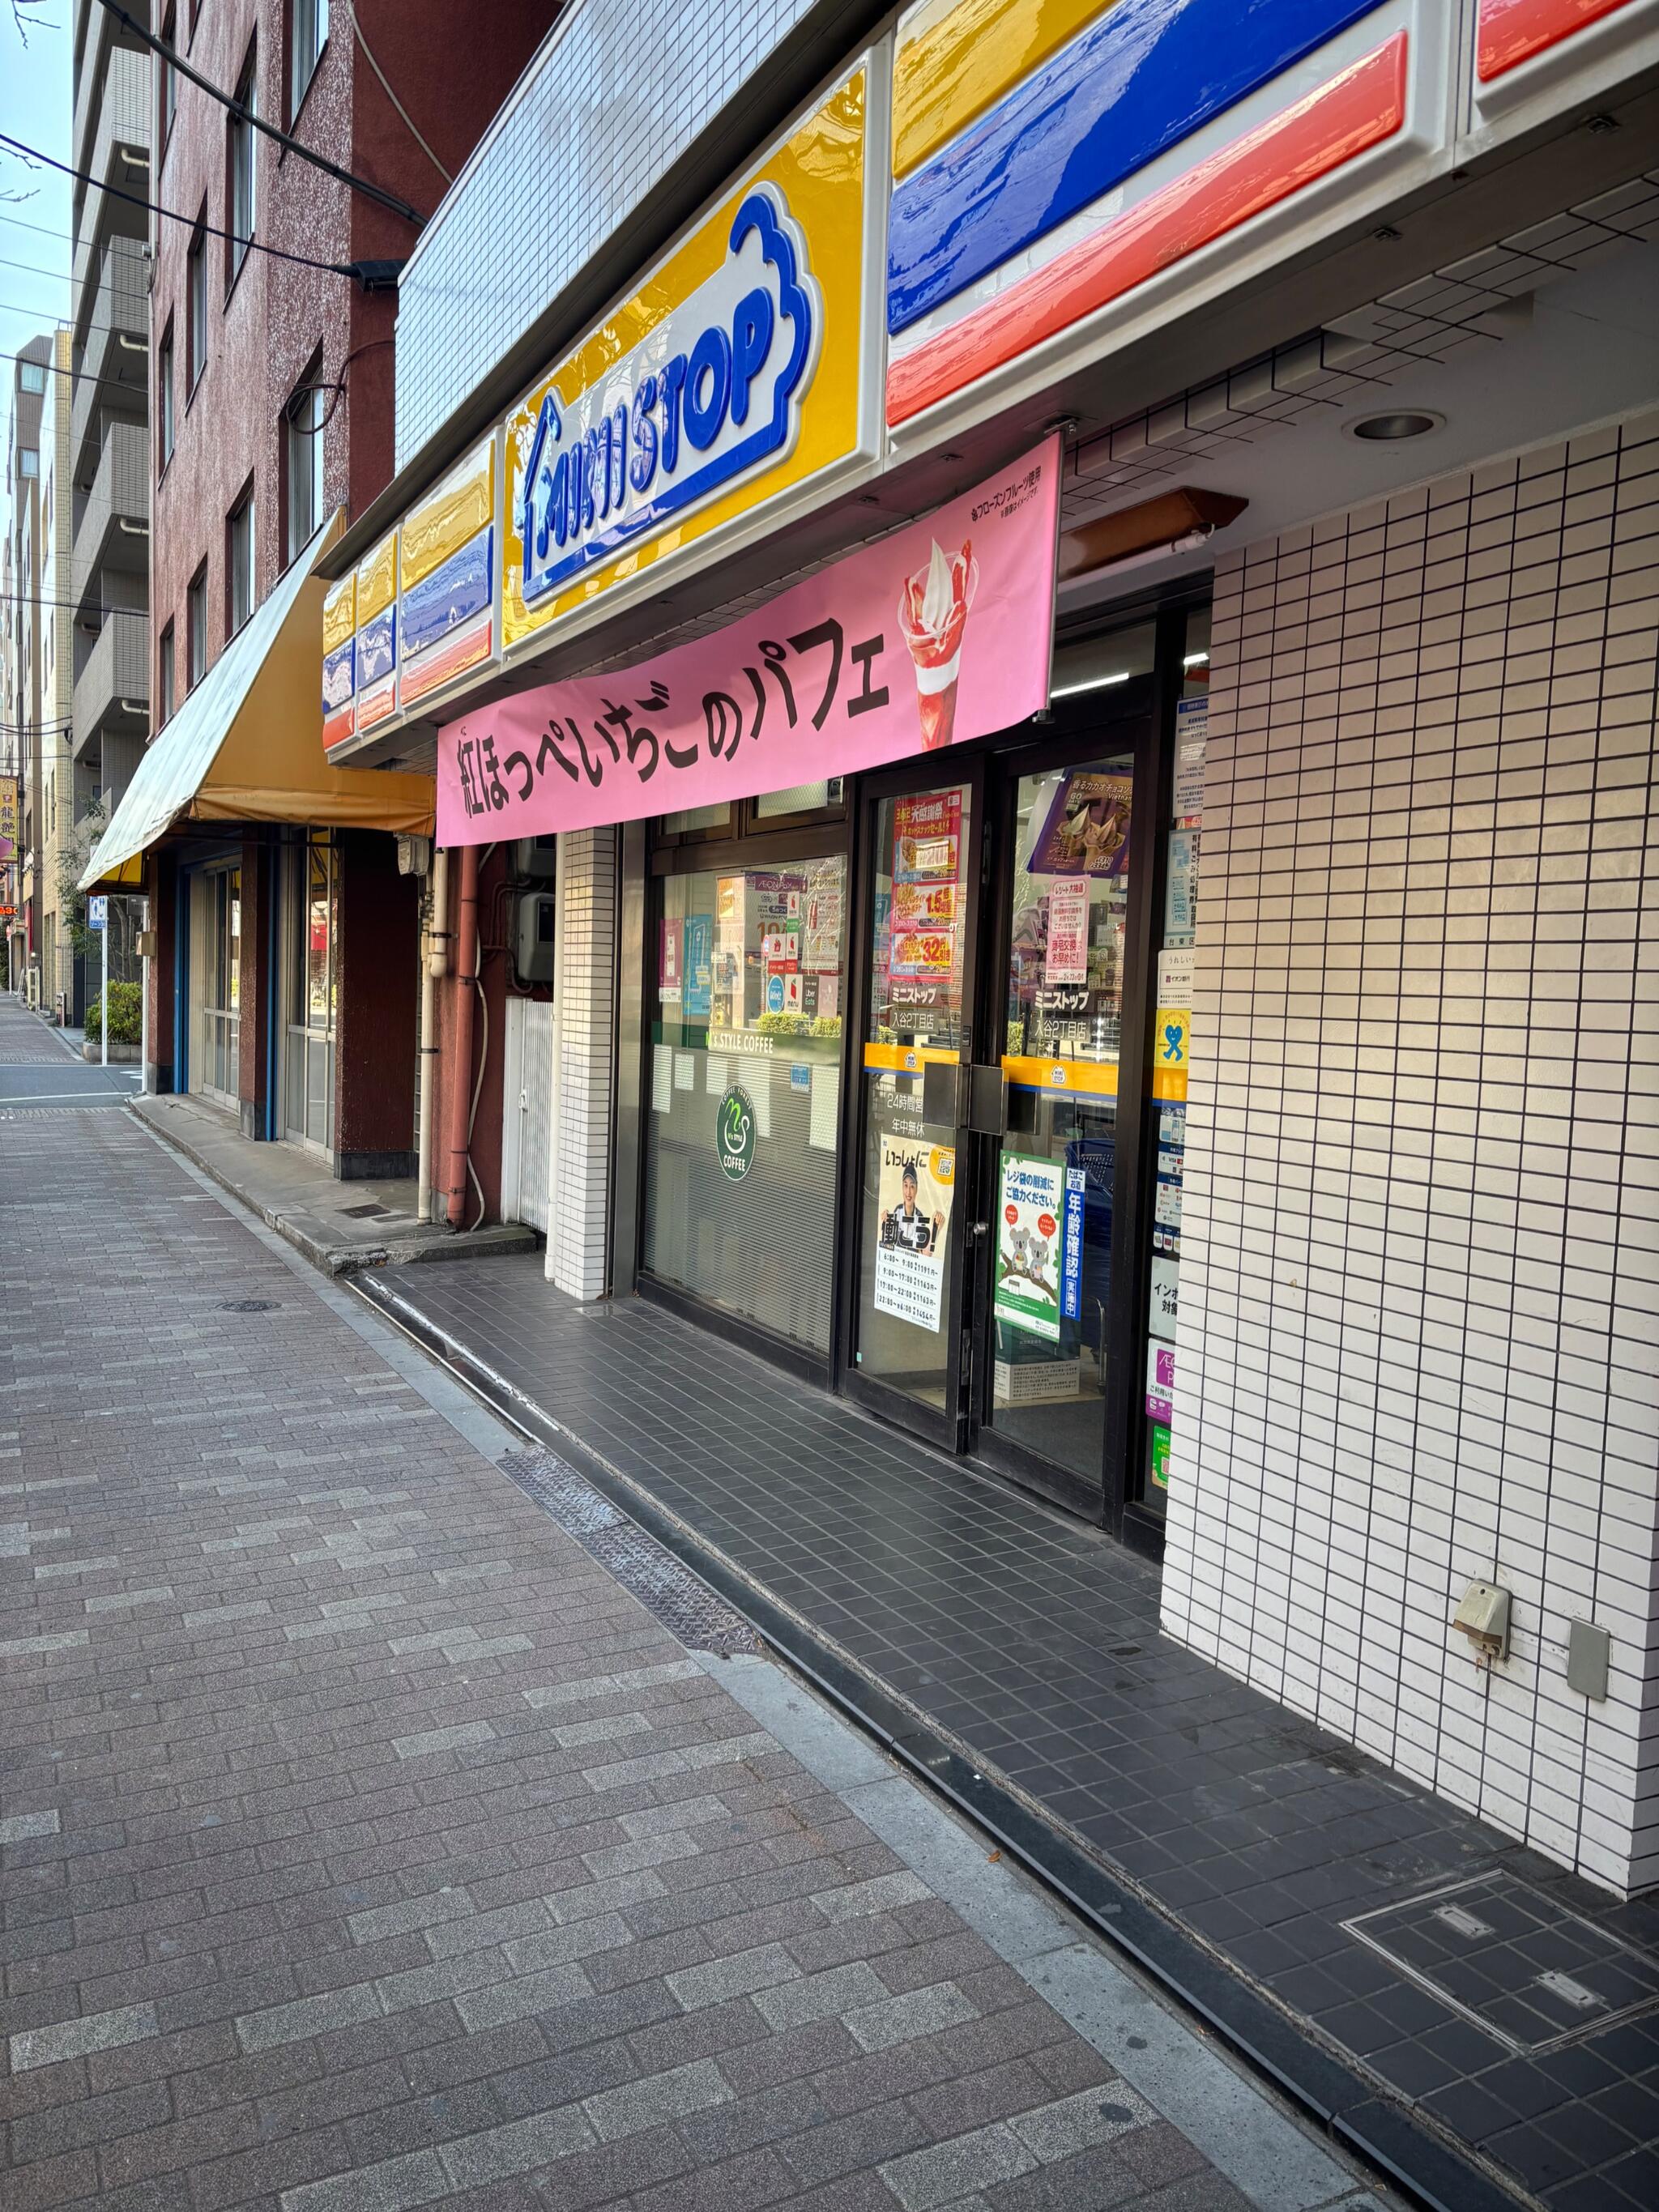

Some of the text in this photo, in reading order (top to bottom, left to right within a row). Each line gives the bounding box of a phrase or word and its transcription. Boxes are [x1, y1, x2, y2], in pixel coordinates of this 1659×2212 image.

[457, 617, 891, 819] 紅ほっぺいちごのパフェ
[1072, 779, 1132, 795] 香るカカオチョコソ
[1168, 957, 1194, 965] うれしい
[805, 988, 815, 997] Uber
[805, 997, 815, 1005] Eats
[892, 987, 936, 1004] ミニストップ
[1035, 991, 1090, 1010] ミニストップ
[892, 1012, 934, 1029] 入谷2丁目店
[1034, 1020, 1086, 1039] 入谷2丁目店
[720, 1034, 741, 1050] STYLE
[744, 1036, 774, 1054] COFFEE
[892, 1119, 925, 1138] 年中無休
[723, 1155, 745, 1171] COFFEE
[1007, 1170, 1055, 1191] レジ袋の削減に
[1066, 1192, 1081, 1279] 年齢確認
